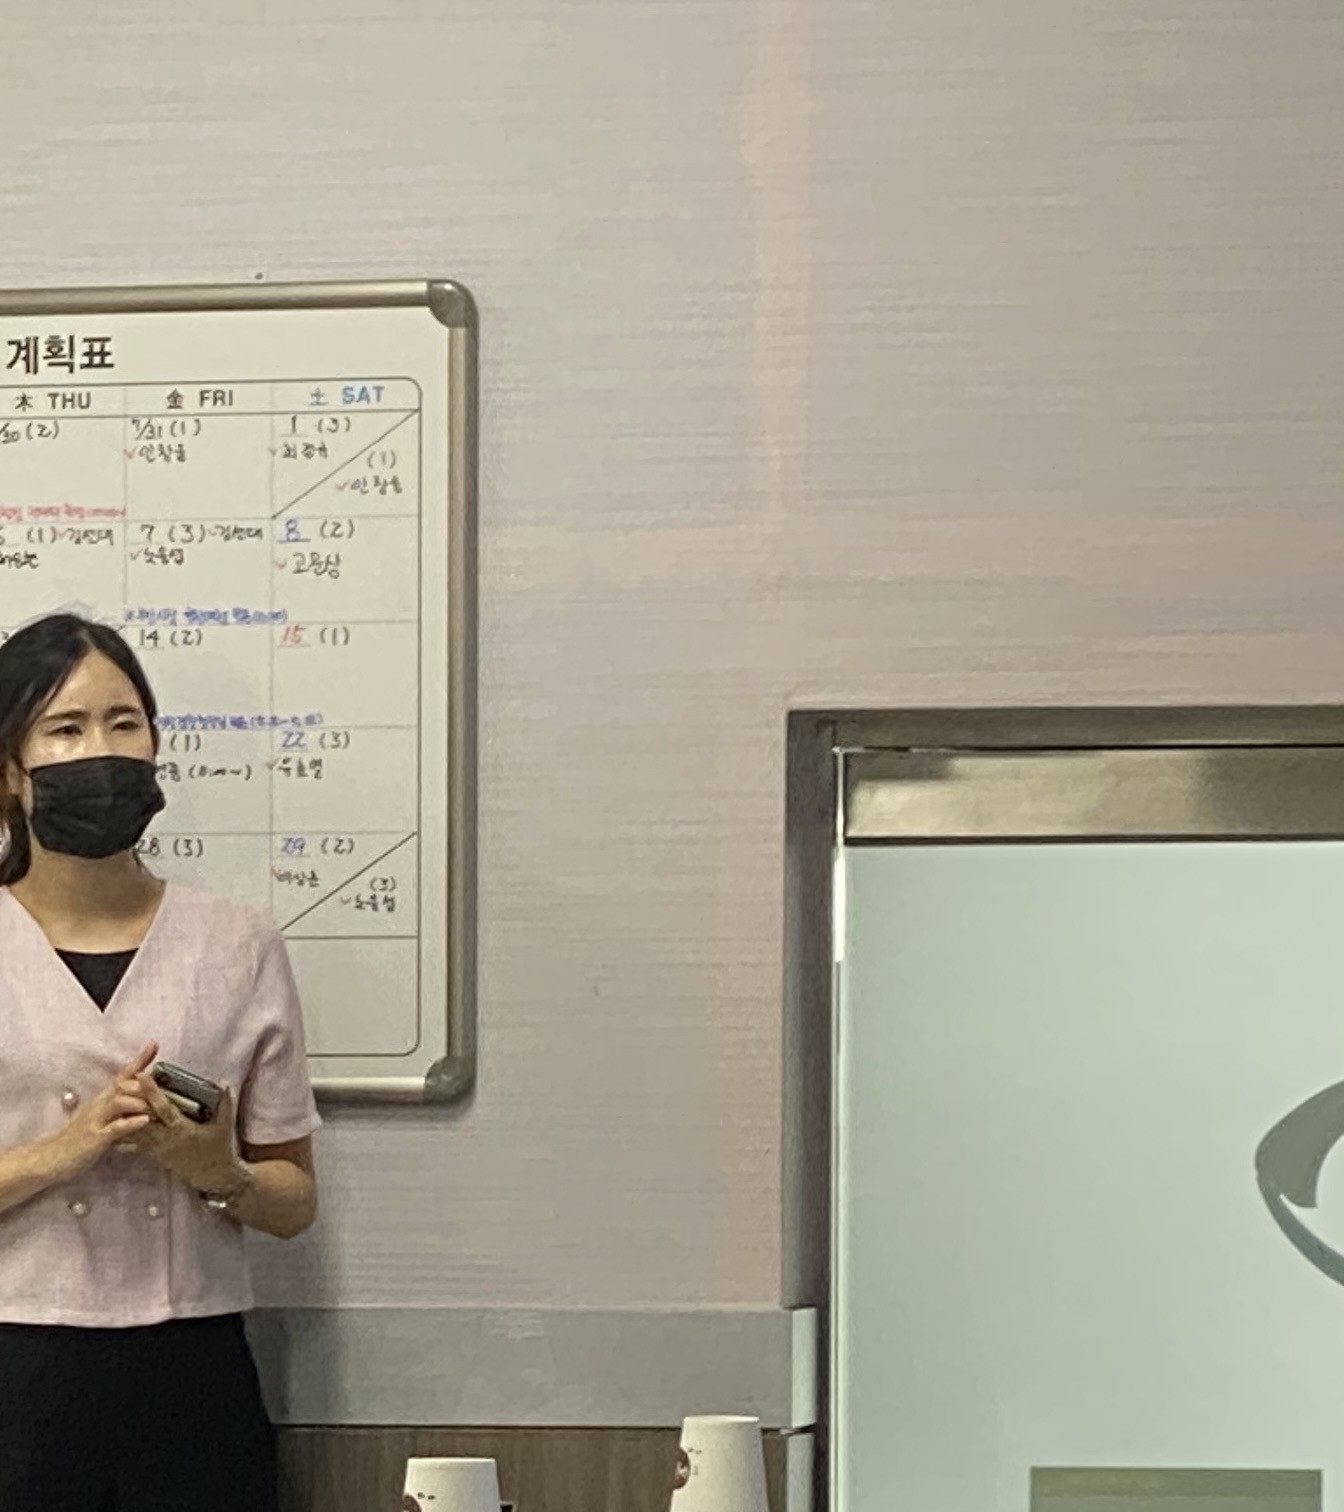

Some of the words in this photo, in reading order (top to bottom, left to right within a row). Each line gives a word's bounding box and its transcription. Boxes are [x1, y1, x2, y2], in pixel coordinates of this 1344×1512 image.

[6, 334, 115, 376] 계획표
[15, 393, 33, 411] 木
[48, 392, 92, 410] THU
[166, 389, 183, 409] 金
[199, 389, 234, 406] FRI
[309, 388, 328, 406] 土
[342, 386, 384, 404] SAT
[26, 420, 60, 440] (2)
[131, 418, 163, 440] 7/31
[170, 419, 202, 436] (1)
[27, 526, 57, 545] (1)
[141, 525, 154, 541] 7
[169, 525, 206, 543] (3)
[286, 519, 301, 541] 8
[320, 520, 355, 539] (2)
[139, 629, 159, 647] 14
[170, 629, 203, 647] (2)
[283, 626, 302, 645] 15
[320, 627, 350, 646] (1)
[169, 734, 201, 752] (1)
[282, 733, 307, 750] 22
[319, 731, 351, 749] (3)
[173, 839, 204, 857] (3)
[282, 838, 306, 855] 29
[321, 838, 353, 855] (2)
[370, 876, 396, 891] (3)
